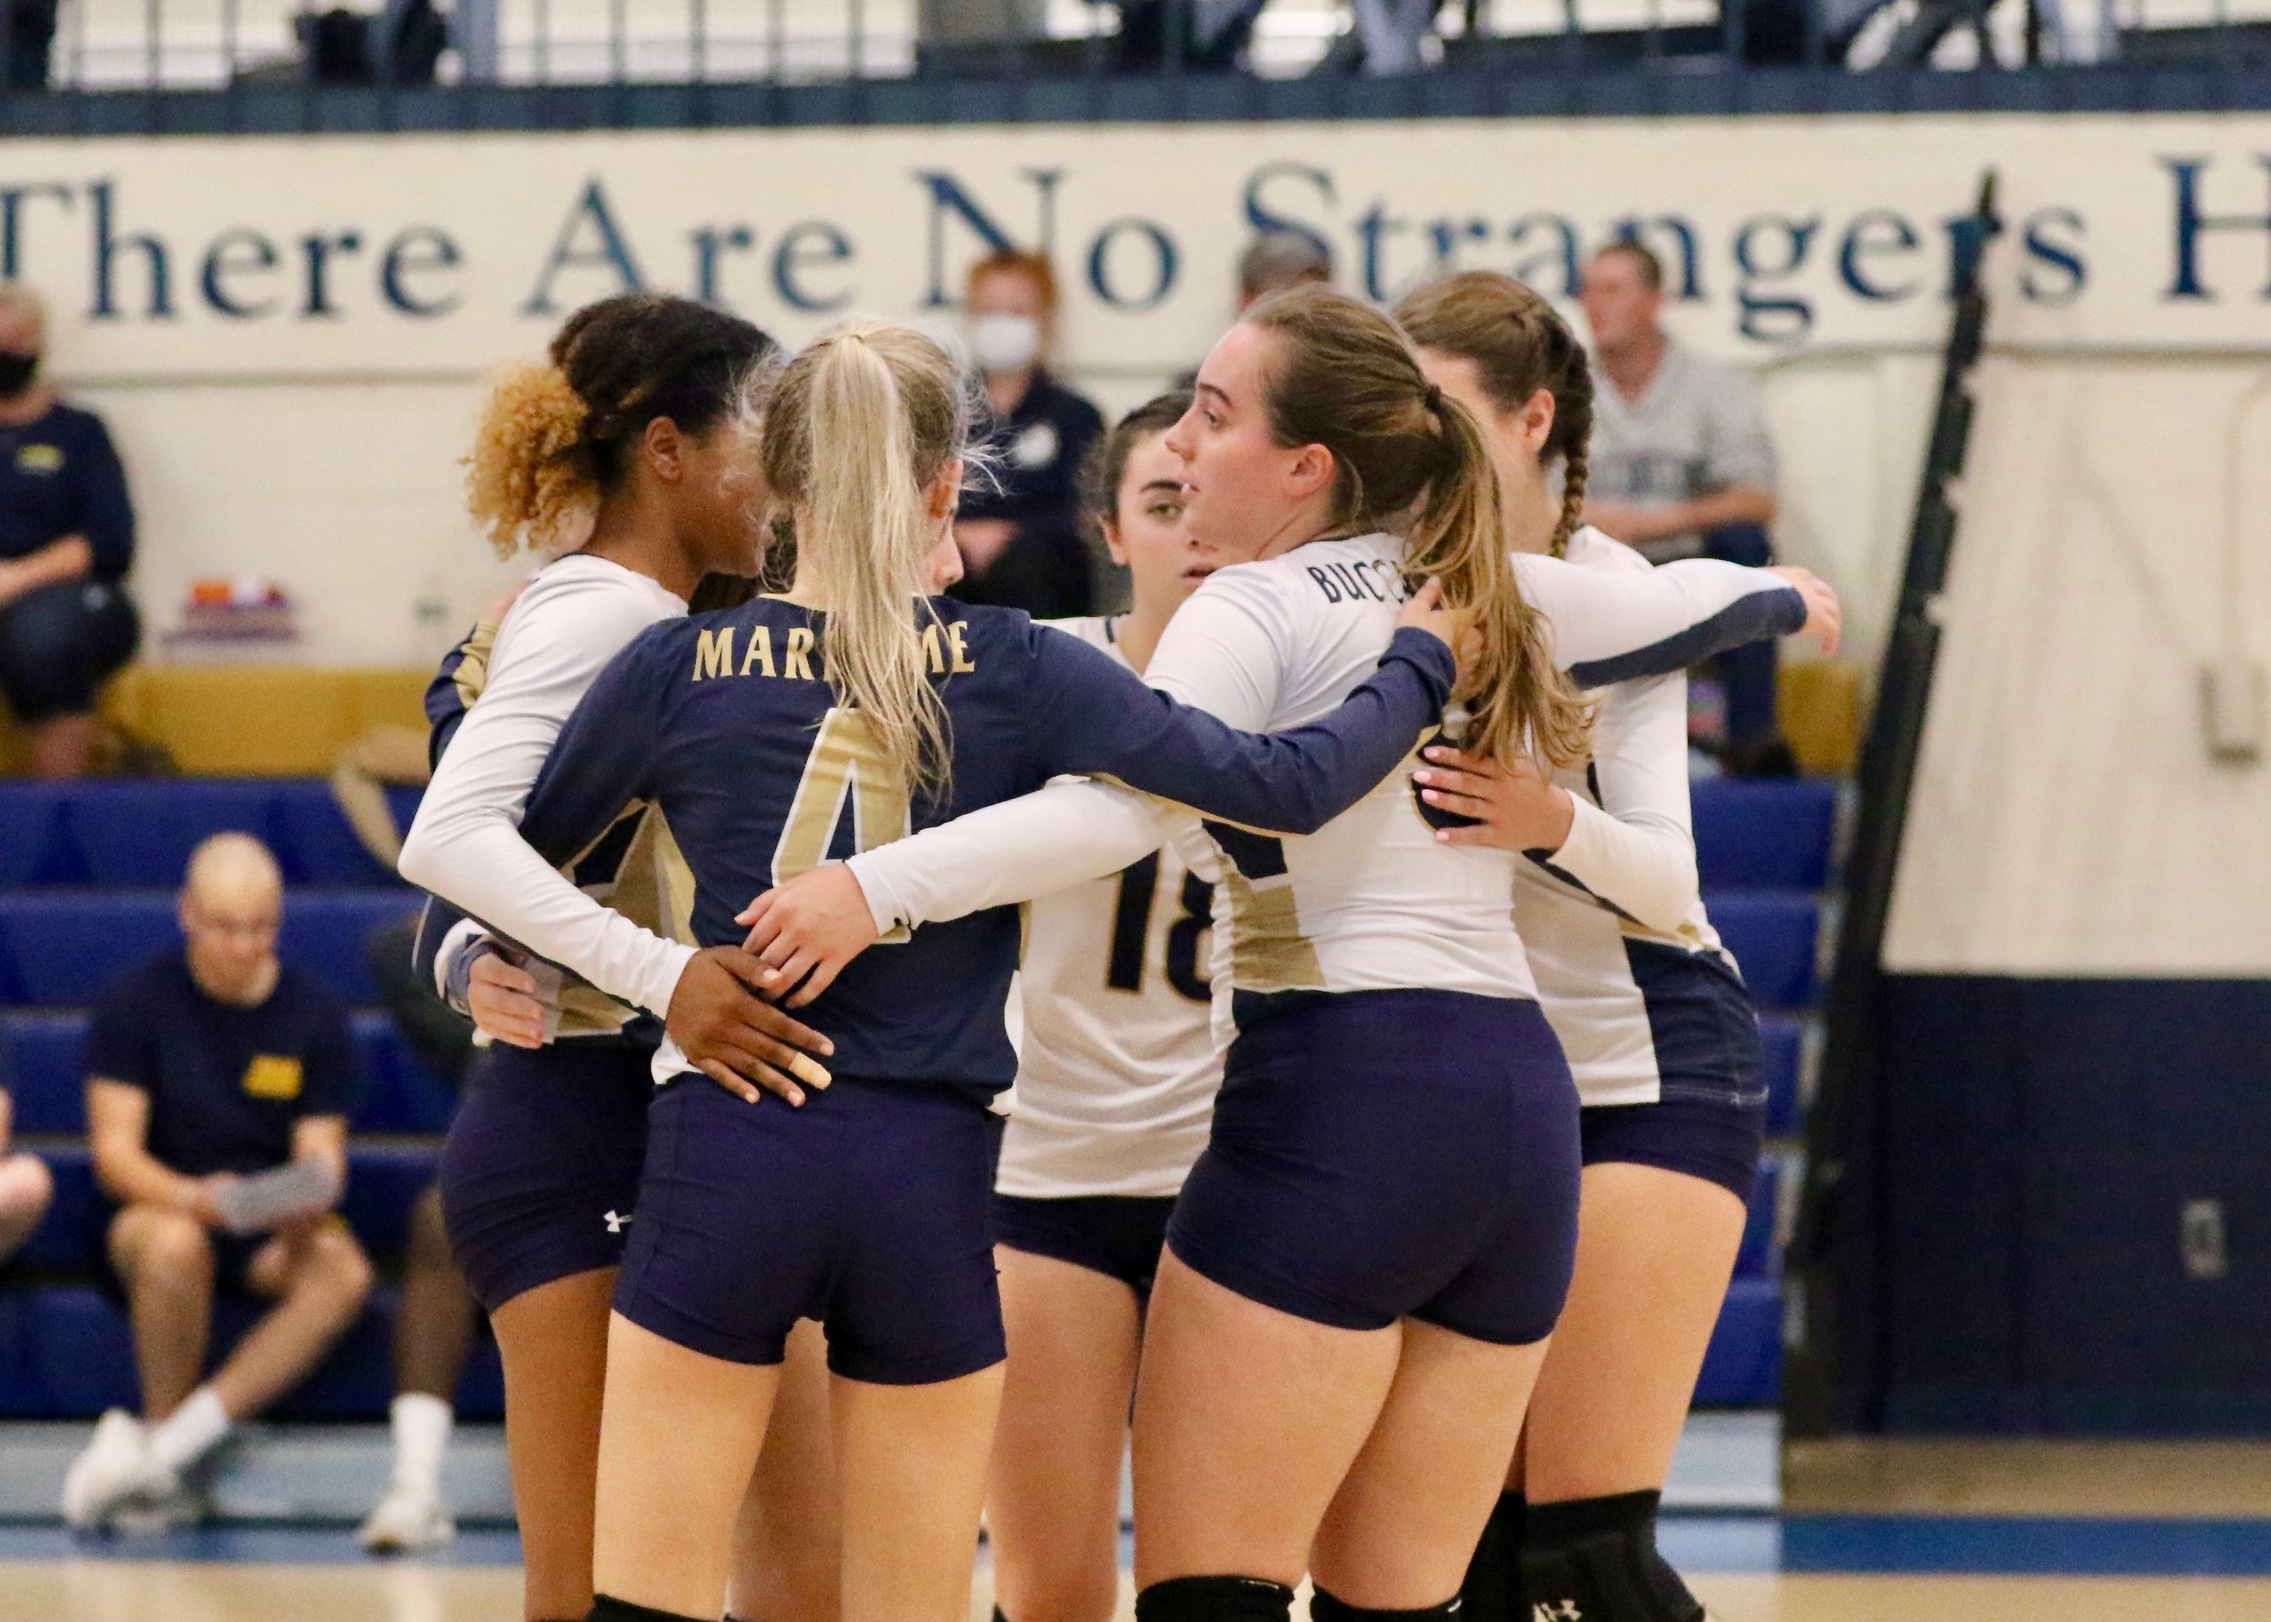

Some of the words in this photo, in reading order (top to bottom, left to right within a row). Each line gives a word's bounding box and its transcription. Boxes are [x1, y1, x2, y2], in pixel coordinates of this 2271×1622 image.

[0, 178, 466, 320] There
[518, 172, 855, 318] Are
[908, 165, 1180, 313] No
[1239, 160, 2089, 344] Strangers
[1306, 558, 1406, 604] BUCC
[692, 620, 976, 682] MARME
[770, 706, 912, 944] 4
